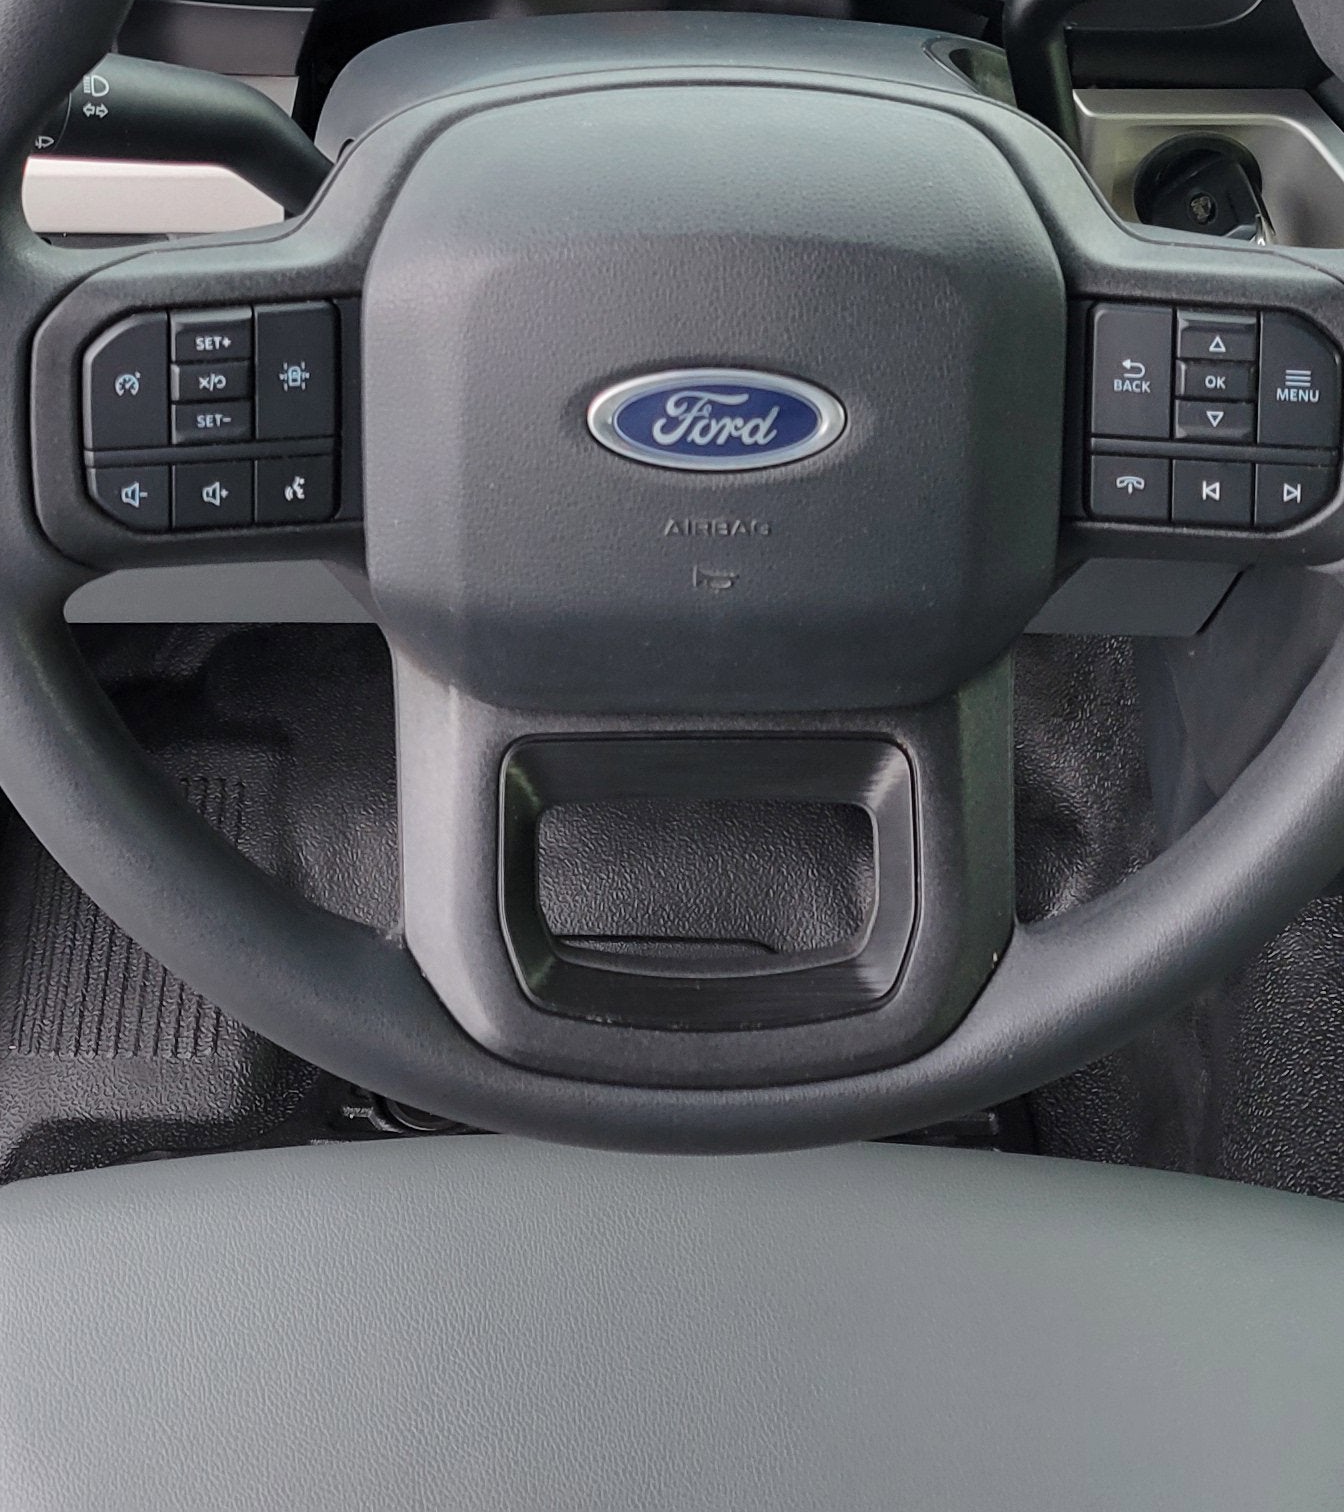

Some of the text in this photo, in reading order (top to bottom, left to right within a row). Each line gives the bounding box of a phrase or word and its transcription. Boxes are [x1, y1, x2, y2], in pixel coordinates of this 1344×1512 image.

[1113, 379, 1151, 393] BACK
[1205, 375, 1226, 389] OK
[1276, 388, 1320, 402] MENU
[652, 390, 780, 446] Ford
[663, 518, 772, 537] AIRBAG
